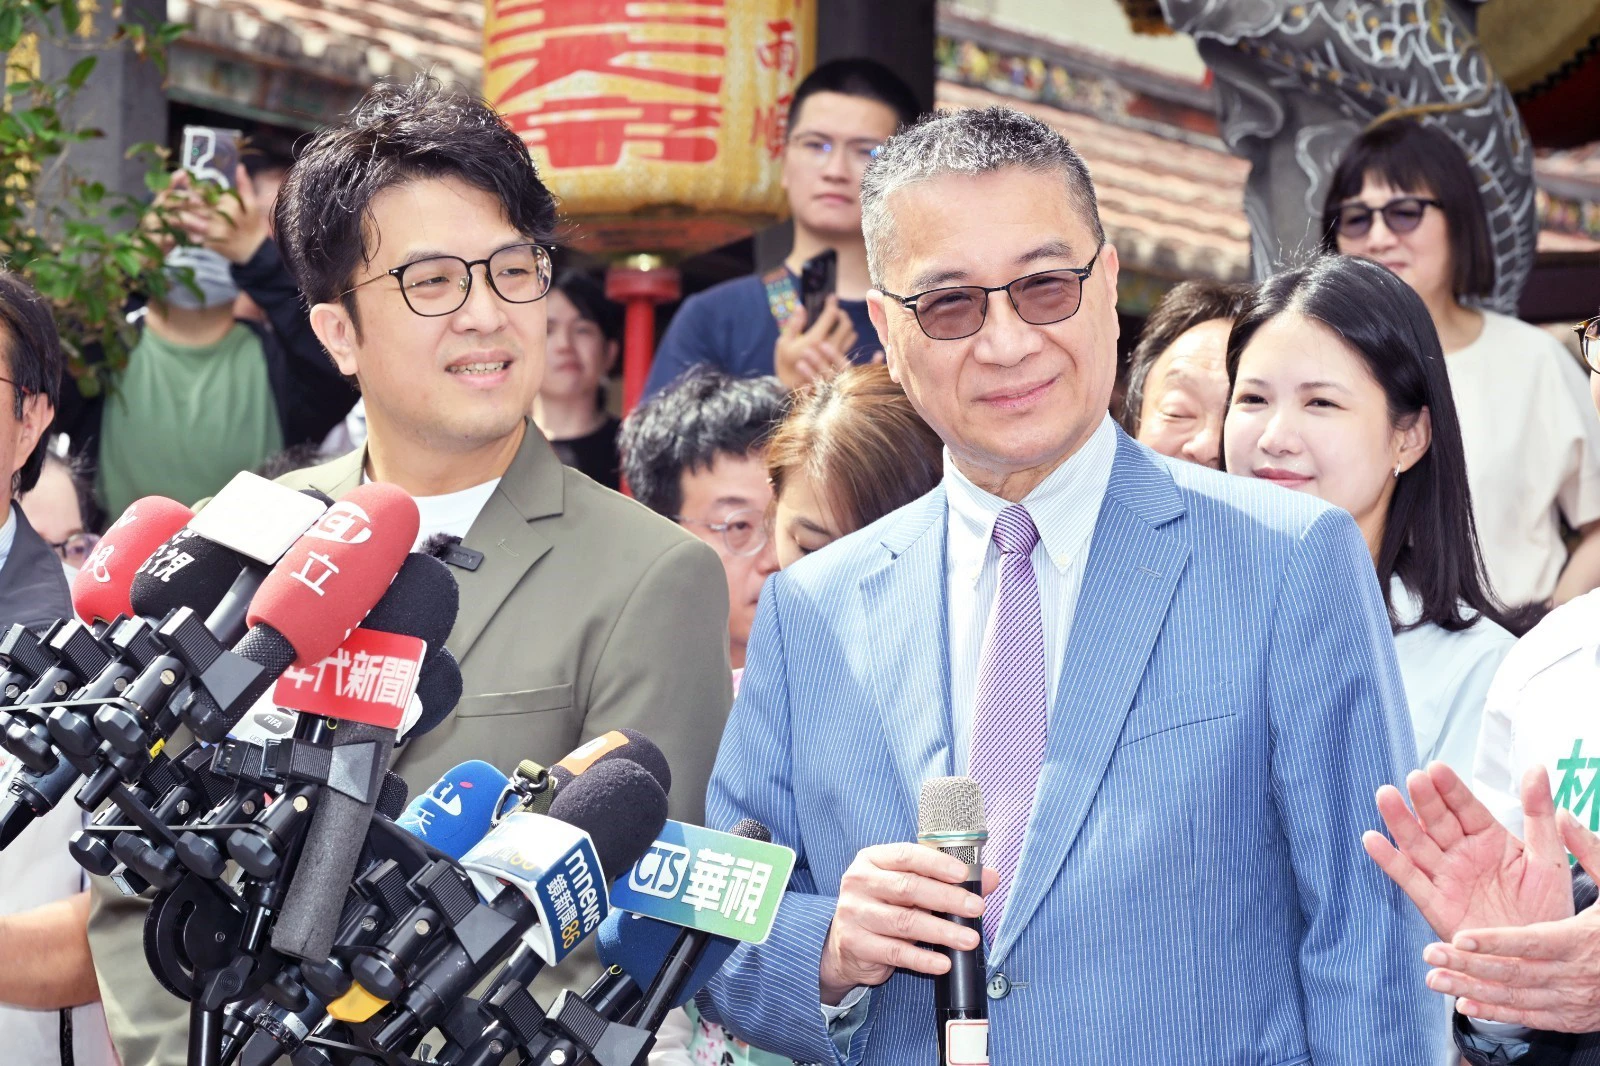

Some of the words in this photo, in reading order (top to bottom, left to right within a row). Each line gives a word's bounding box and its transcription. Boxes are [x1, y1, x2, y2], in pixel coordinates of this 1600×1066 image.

[263, 714, 283, 729] FIFA
[565, 848, 601, 933] mnews
[634, 846, 687, 893] CTS
[681, 848, 773, 925] 華視
